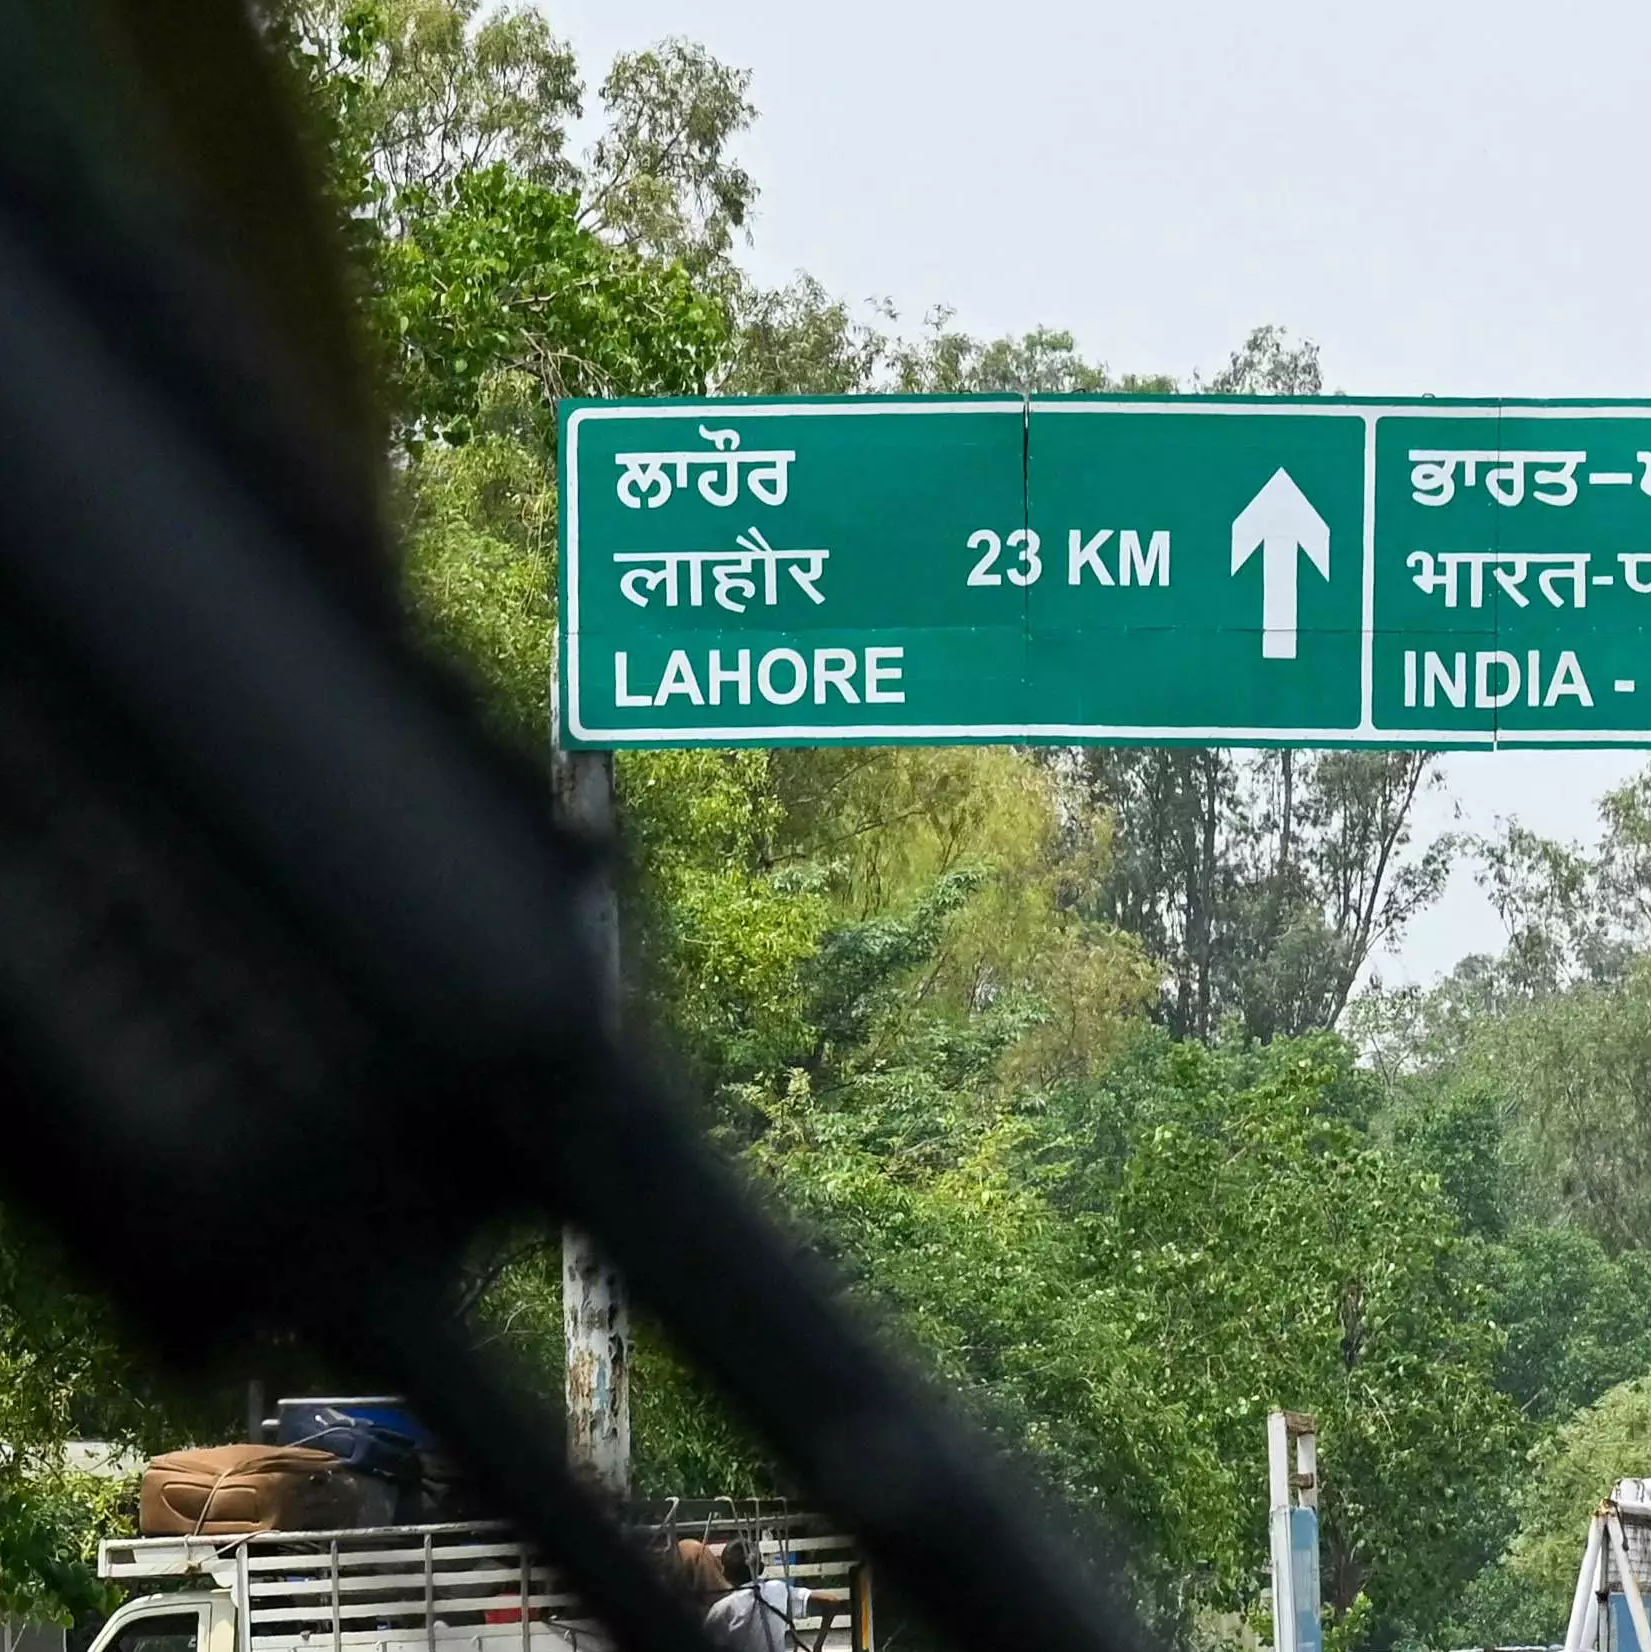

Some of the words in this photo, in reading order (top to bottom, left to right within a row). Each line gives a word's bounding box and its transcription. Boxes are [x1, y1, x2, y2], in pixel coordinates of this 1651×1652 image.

[615, 424, 796, 509] ਲਾਹੌਰ
[613, 526, 830, 613] लाहौर
[966, 528, 1042, 586] 23
[1068, 529, 1170, 586] KM
[615, 646, 906, 707] LAHORE
[1404, 650, 1594, 709] INDIA
